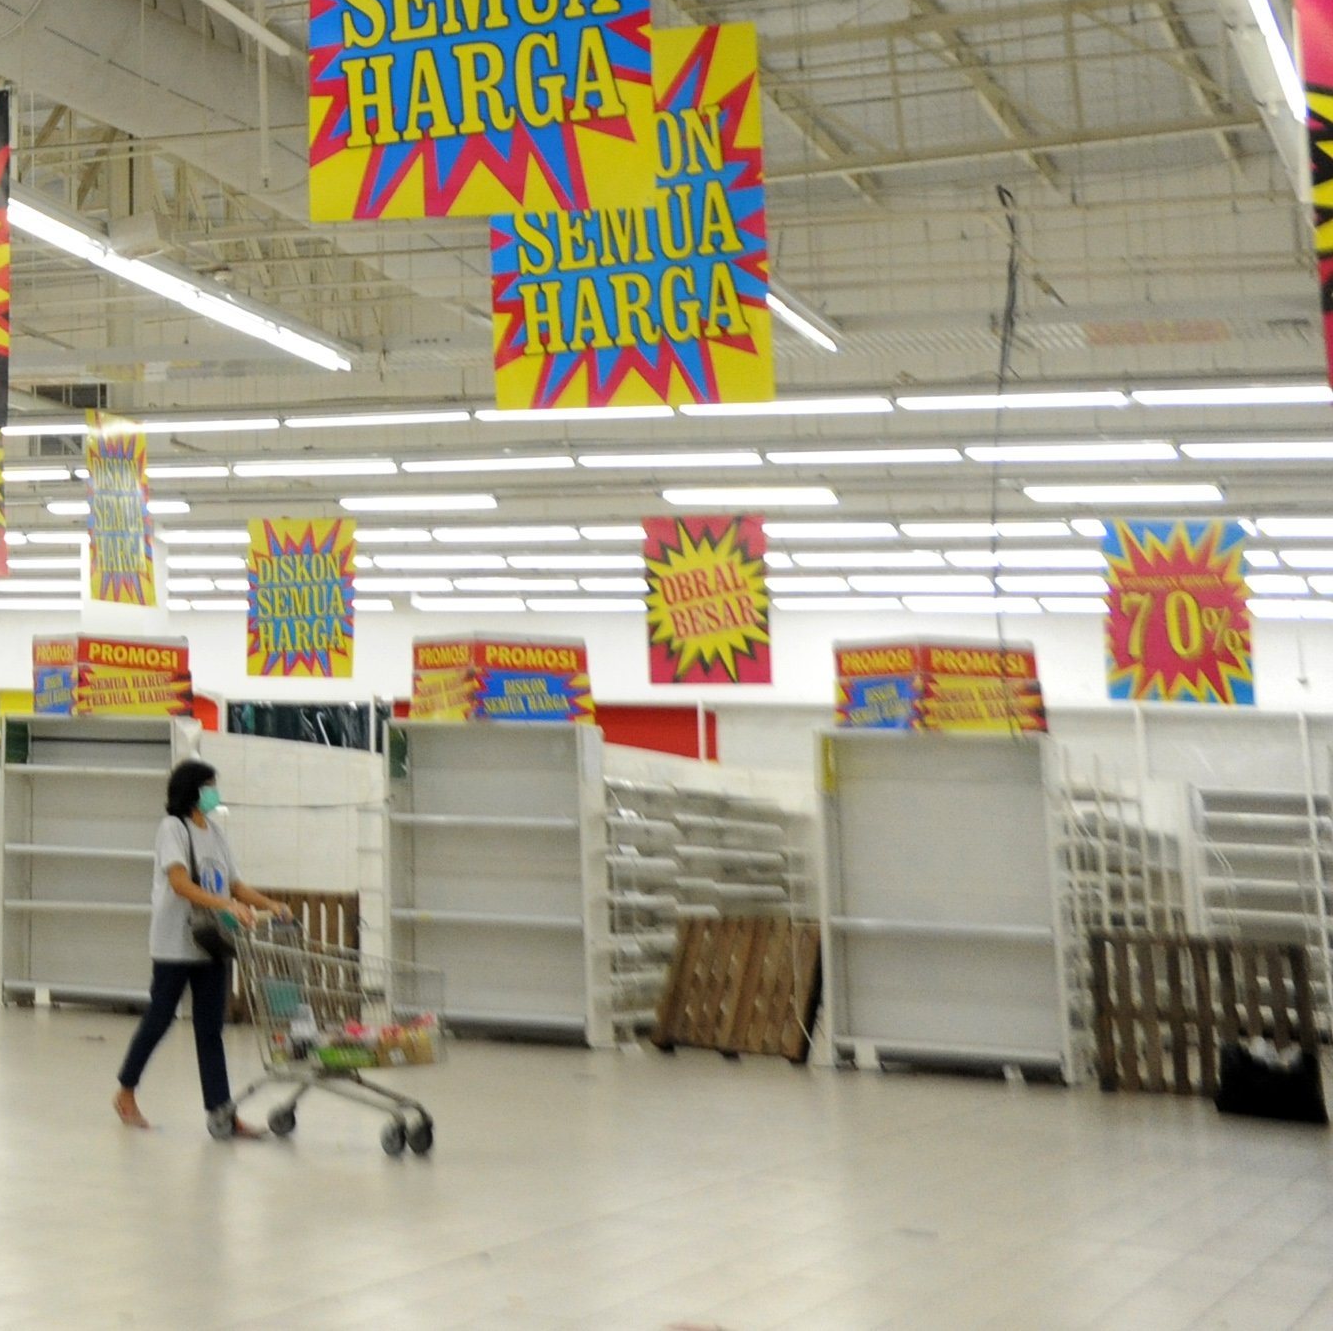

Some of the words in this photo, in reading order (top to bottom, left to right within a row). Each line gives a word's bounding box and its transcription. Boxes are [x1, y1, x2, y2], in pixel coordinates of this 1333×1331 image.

[341, 24, 626, 149] HARGA
[513, 180, 745, 277] SEMUA
[517, 260, 751, 356] HARGA
[256, 554, 341, 586] DISKON
[660, 560, 749, 608] OBRAL
[256, 581, 345, 620] SEMUA
[670, 595, 762, 642] BESAR
[257, 616, 347, 653] HARGA
[1120, 589, 1243, 660] 70%
[88, 642, 179, 669] PROMOSI
[485, 644, 578, 670] PROMOSI
